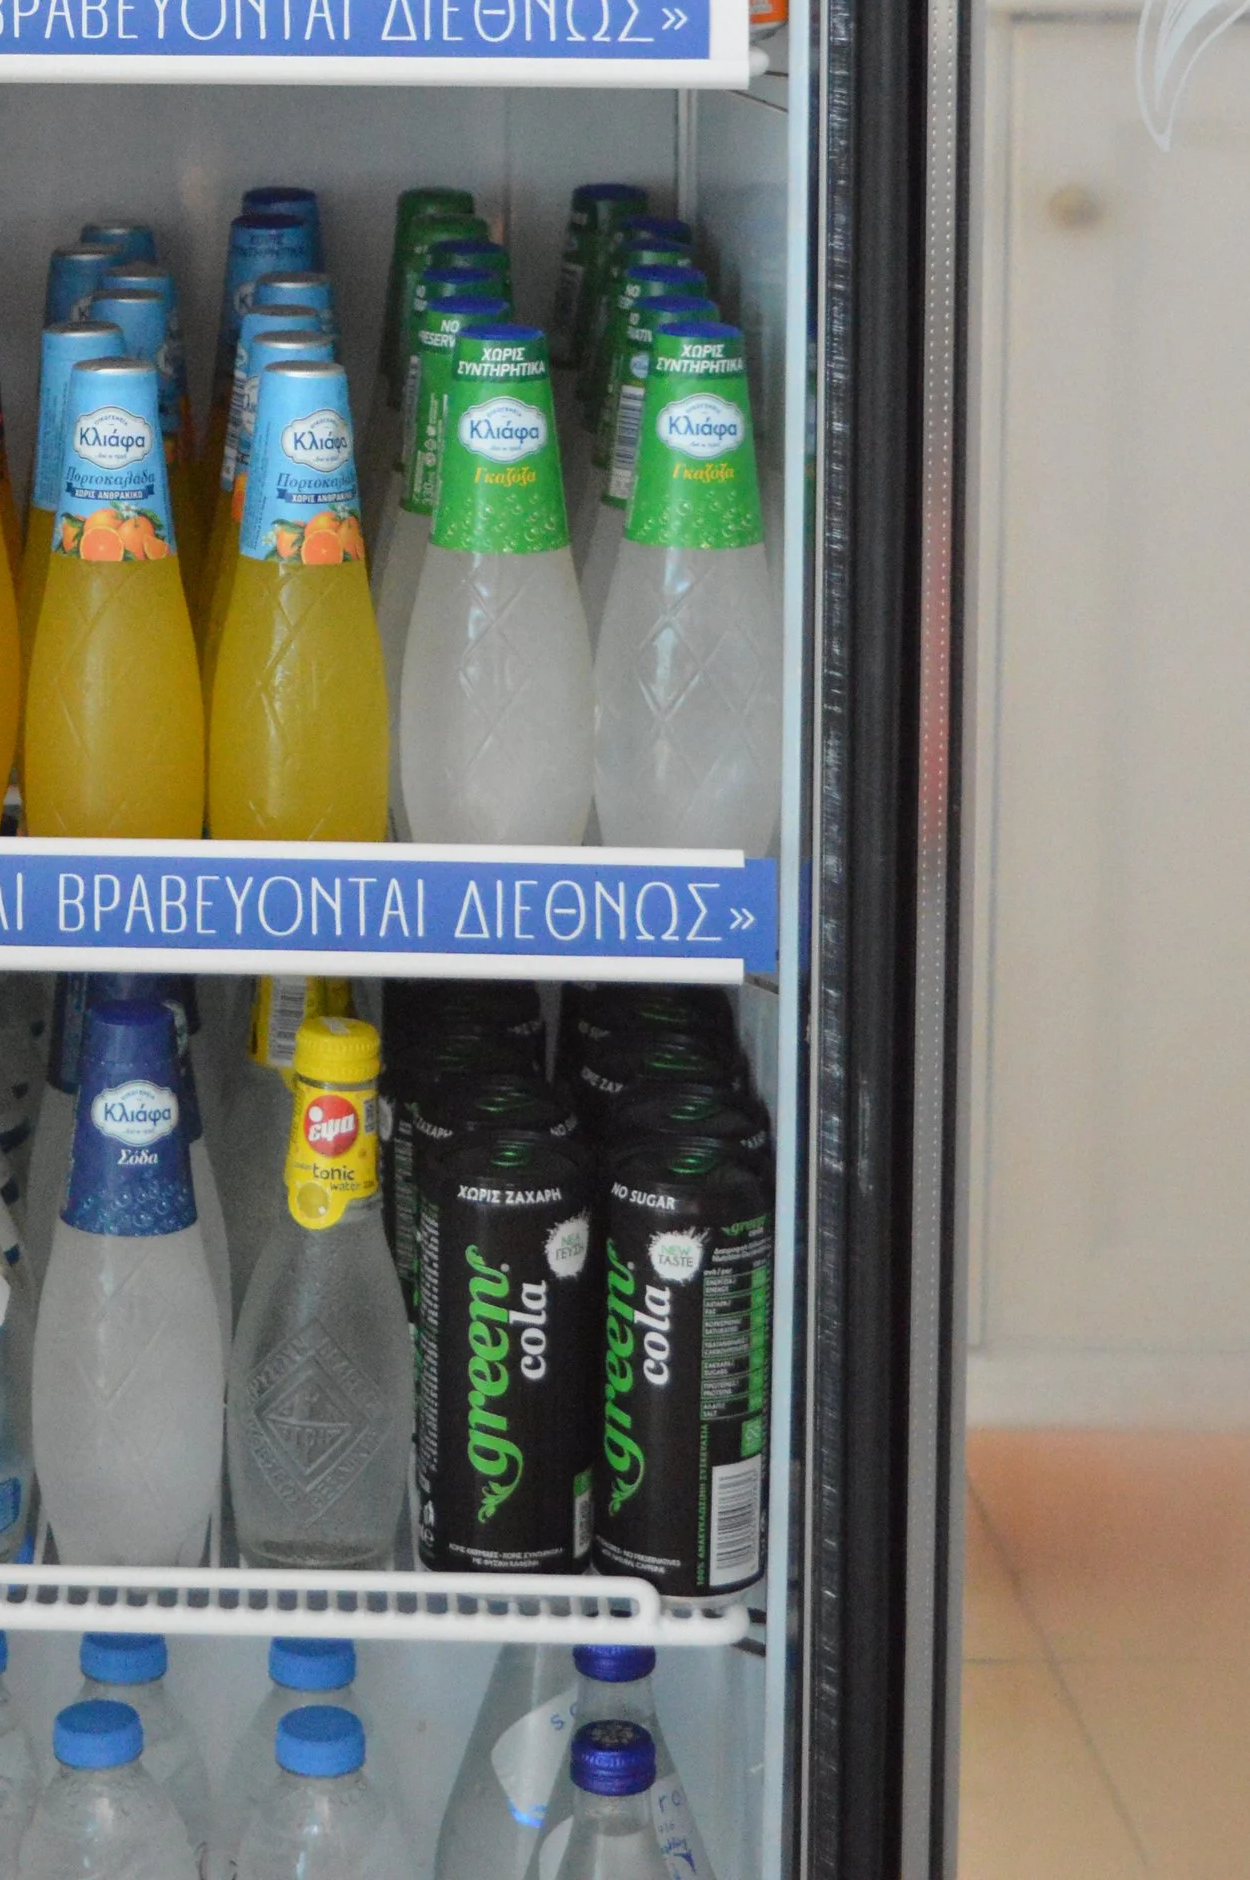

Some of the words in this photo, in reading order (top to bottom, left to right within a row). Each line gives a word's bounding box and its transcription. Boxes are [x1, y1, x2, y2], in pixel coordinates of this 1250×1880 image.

[481, 347, 526, 362] ΧΩΡΙΣ
[680, 343, 725, 359] ΧΩΡΙΣ
[457, 360, 547, 378] ΣΥΝΤΗΡΗΤΙΚΑ
[656, 357, 744, 374] ΣΥΝΤΗΡΗΤΙΚΑ
[79, 426, 146, 453] Κλιάφα
[469, 418, 539, 445] Κλιάφα
[668, 415, 738, 442] Κλιάφα
[58, 872, 424, 938] ΒΡΑΒΕΥΟΝΤΑΙ
[453, 878, 755, 943] ΔΙΕΘΝΩΣ»
[103, 1102, 172, 1127] Κλιάφα
[117, 1148, 159, 1166] Σόδα
[311, 1162, 356, 1181] tonic
[457, 1184, 501, 1205] ΧΩΡΙΣ
[505, 1187, 563, 1206] ΖΑΧΑΡΗ
[610, 1181, 629, 1200] NO
[629, 1189, 676, 1211] SUGAR
[661, 1244, 691, 1255] NEW
[658, 1254, 693, 1269] TASTE
[465, 1245, 523, 1520] green
[509, 1280, 547, 1380] cola
[604, 1239, 645, 1516] green
[634, 1285, 672, 1387] cola
